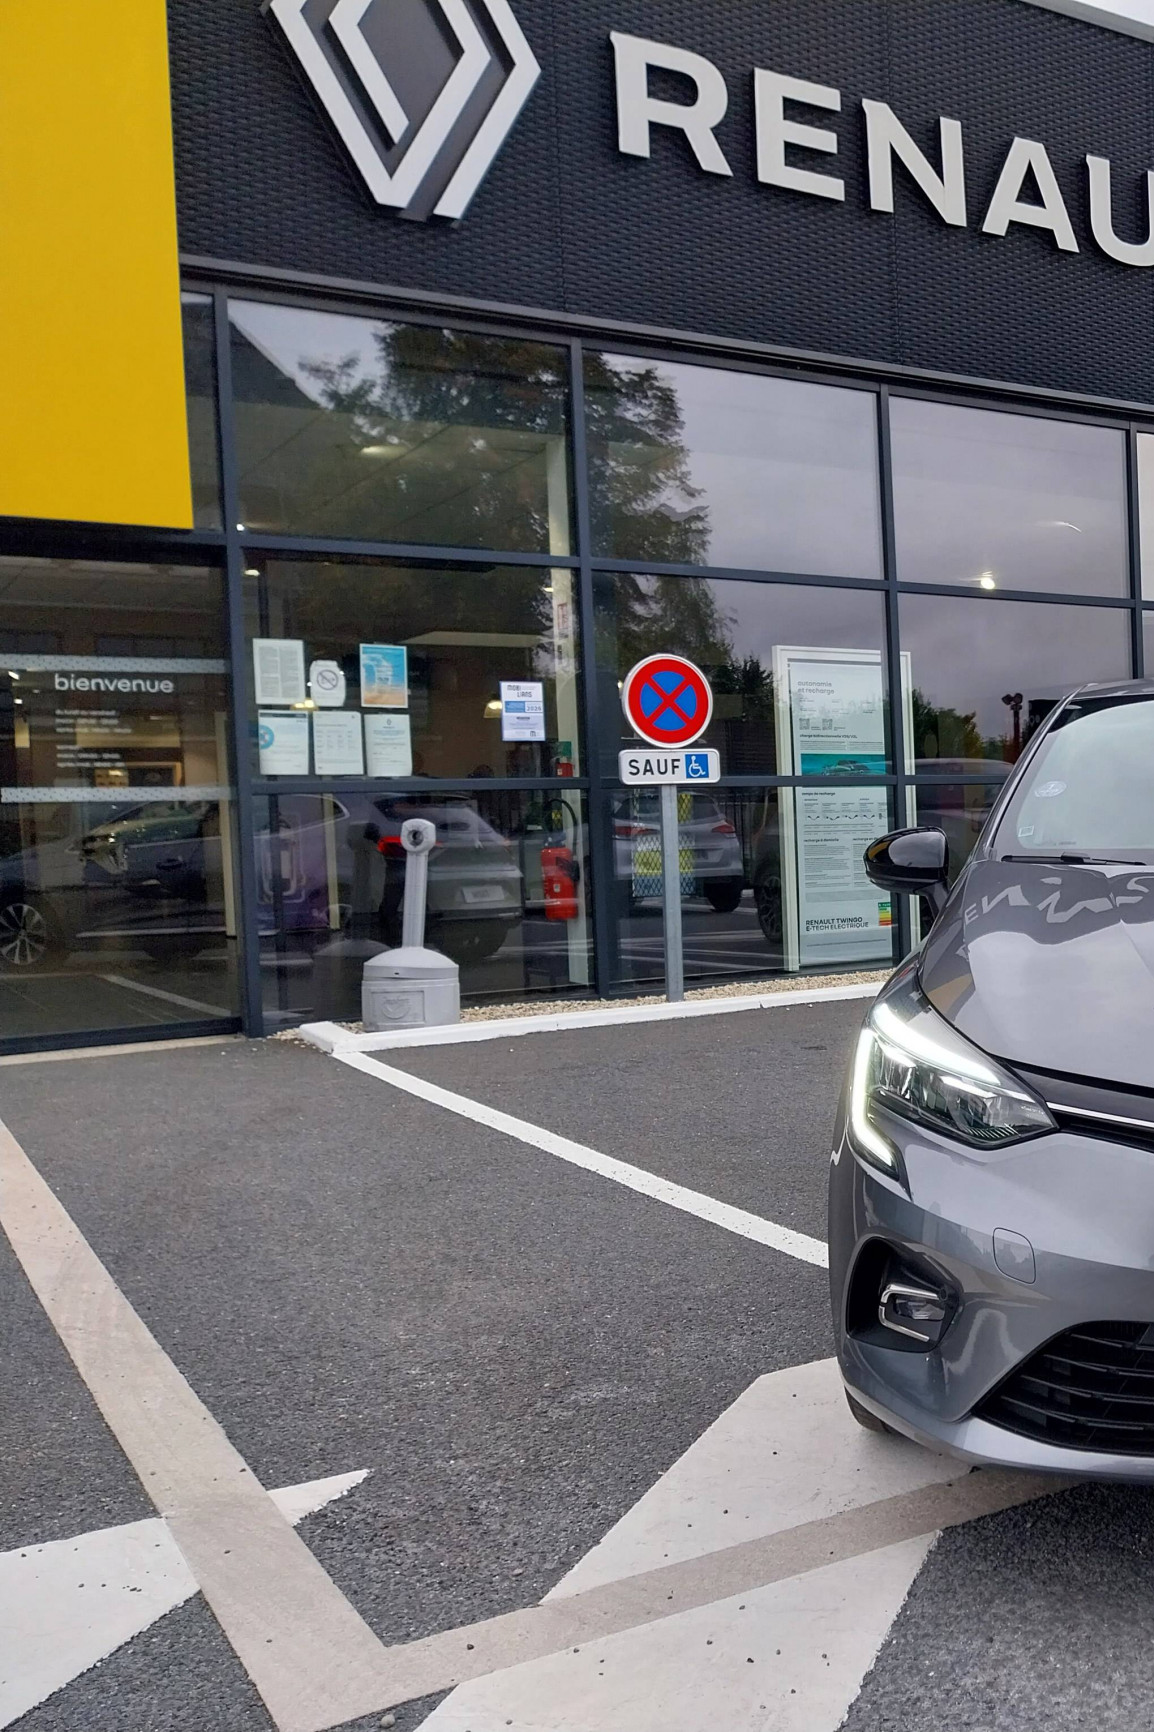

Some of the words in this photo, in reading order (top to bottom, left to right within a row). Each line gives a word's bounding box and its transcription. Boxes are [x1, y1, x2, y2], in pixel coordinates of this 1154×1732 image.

[54, 673, 175, 694] bienvenue
[805, 688, 835, 696] recharge
[628, 758, 681, 776] SAUF
[805, 918, 836, 926] RENAULT
[836, 916, 863, 924] TWINGO
[805, 924, 830, 932] E-TECH
[830, 921, 869, 930] ELECTRIQUE
